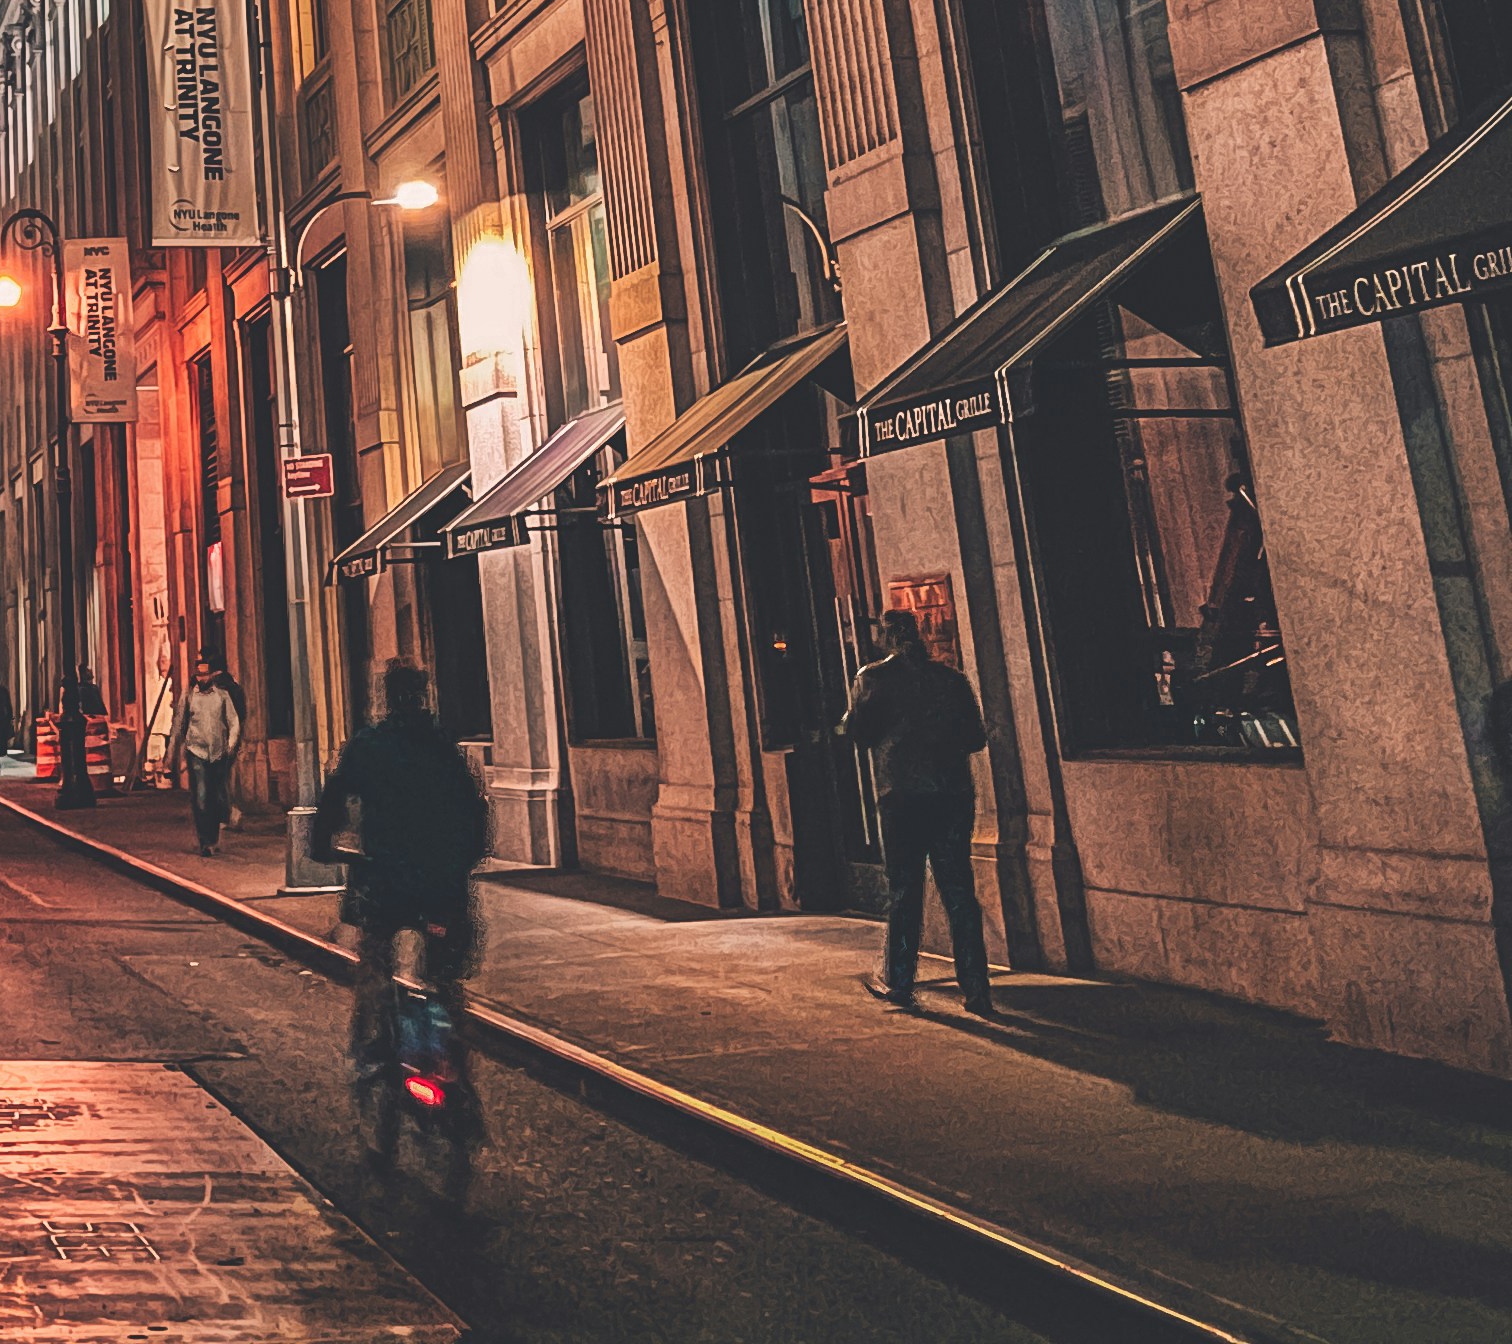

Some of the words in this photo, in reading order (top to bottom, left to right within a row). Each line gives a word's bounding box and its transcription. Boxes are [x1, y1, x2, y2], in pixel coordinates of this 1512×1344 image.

[174, 8, 195, 39] AT
[196, 7, 218, 58] NYU
[175, 43, 200, 143] TRINITY
[199, 64, 224, 181] LANGONE
[173, 209, 196, 220] NYU
[85, 268, 98, 289] AT
[98, 268, 113, 303] NYU
[1315, 289, 1354, 320] THE
[1353, 253, 1472, 316] CAPITAL
[86, 293, 103, 358] TRINITY
[101, 305, 117, 382] LANGONE
[874, 418, 895, 441] THE
[895, 398, 957, 441] CAPITAL
[955, 392, 992, 420] GRILLE
